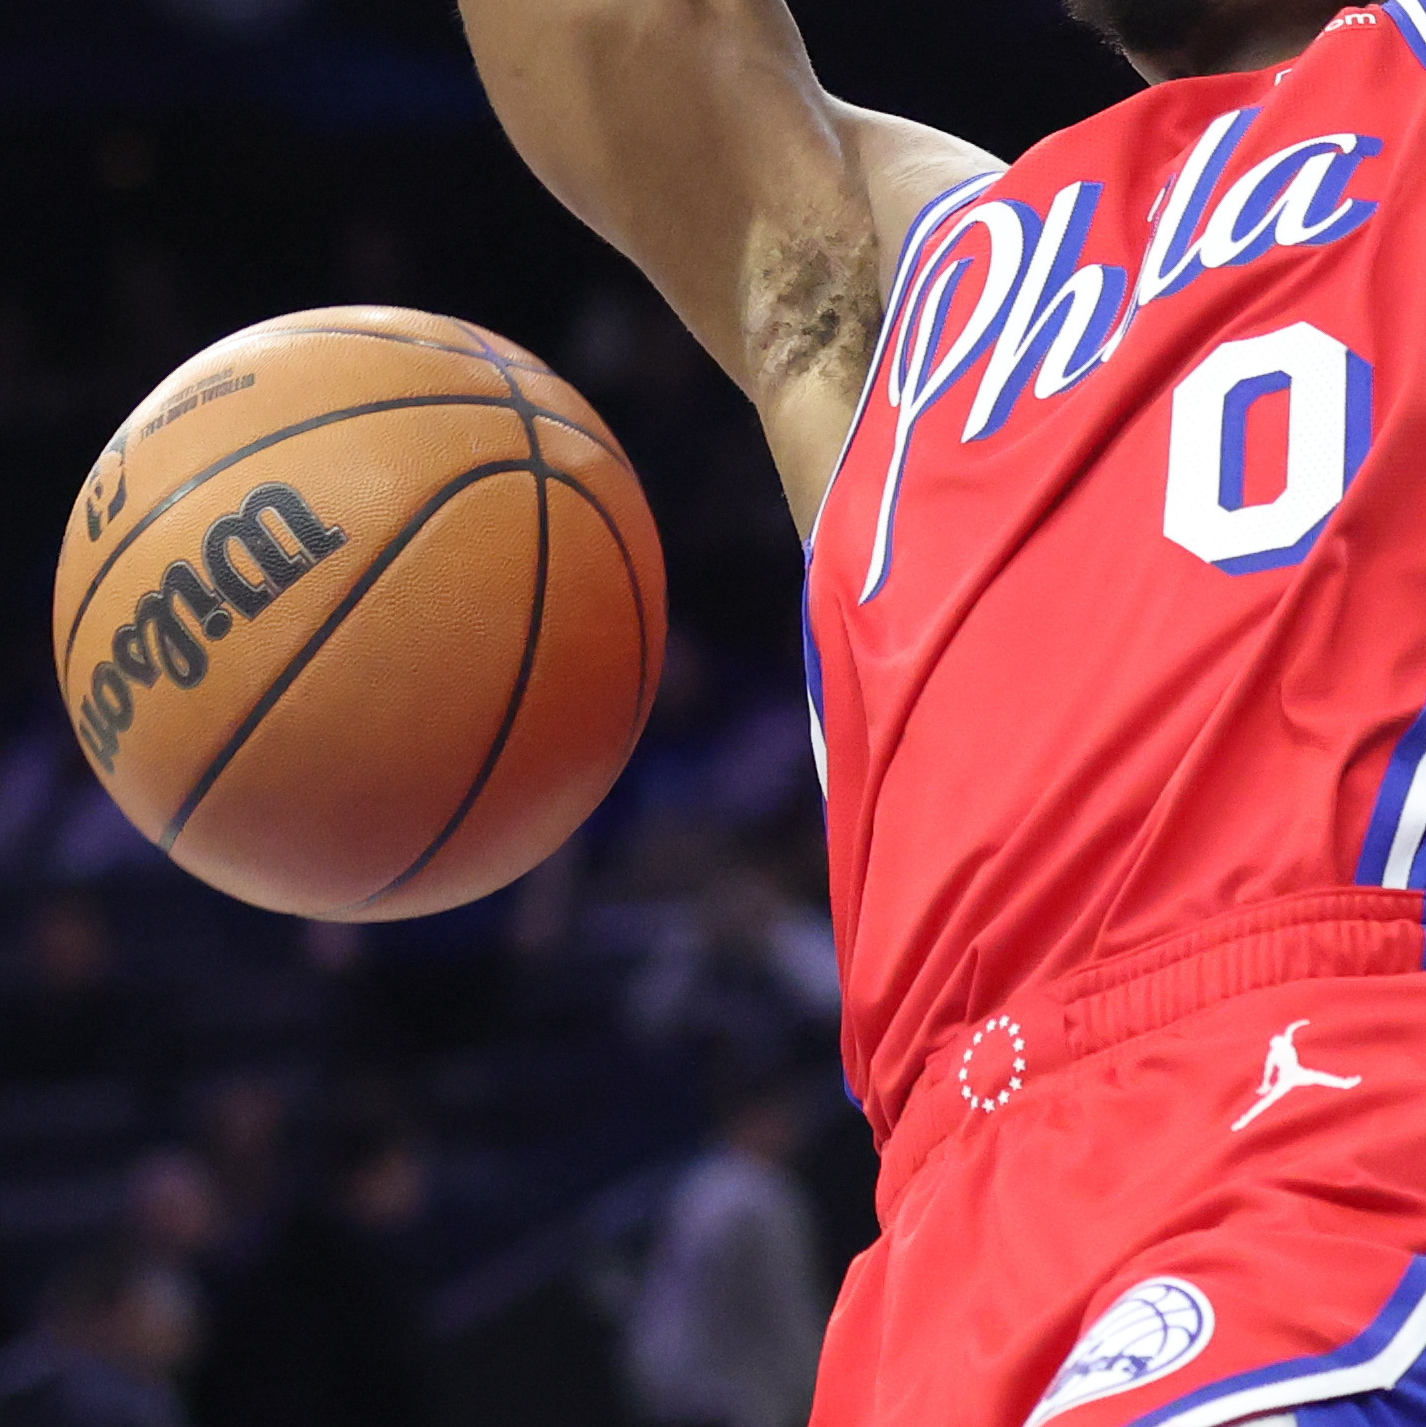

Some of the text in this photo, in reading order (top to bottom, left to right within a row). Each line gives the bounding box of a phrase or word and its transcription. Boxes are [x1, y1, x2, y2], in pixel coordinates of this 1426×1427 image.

[858, 106, 1384, 606] Phla
[1163, 321, 1375, 576] 0
[79, 480, 350, 774] Wilson
